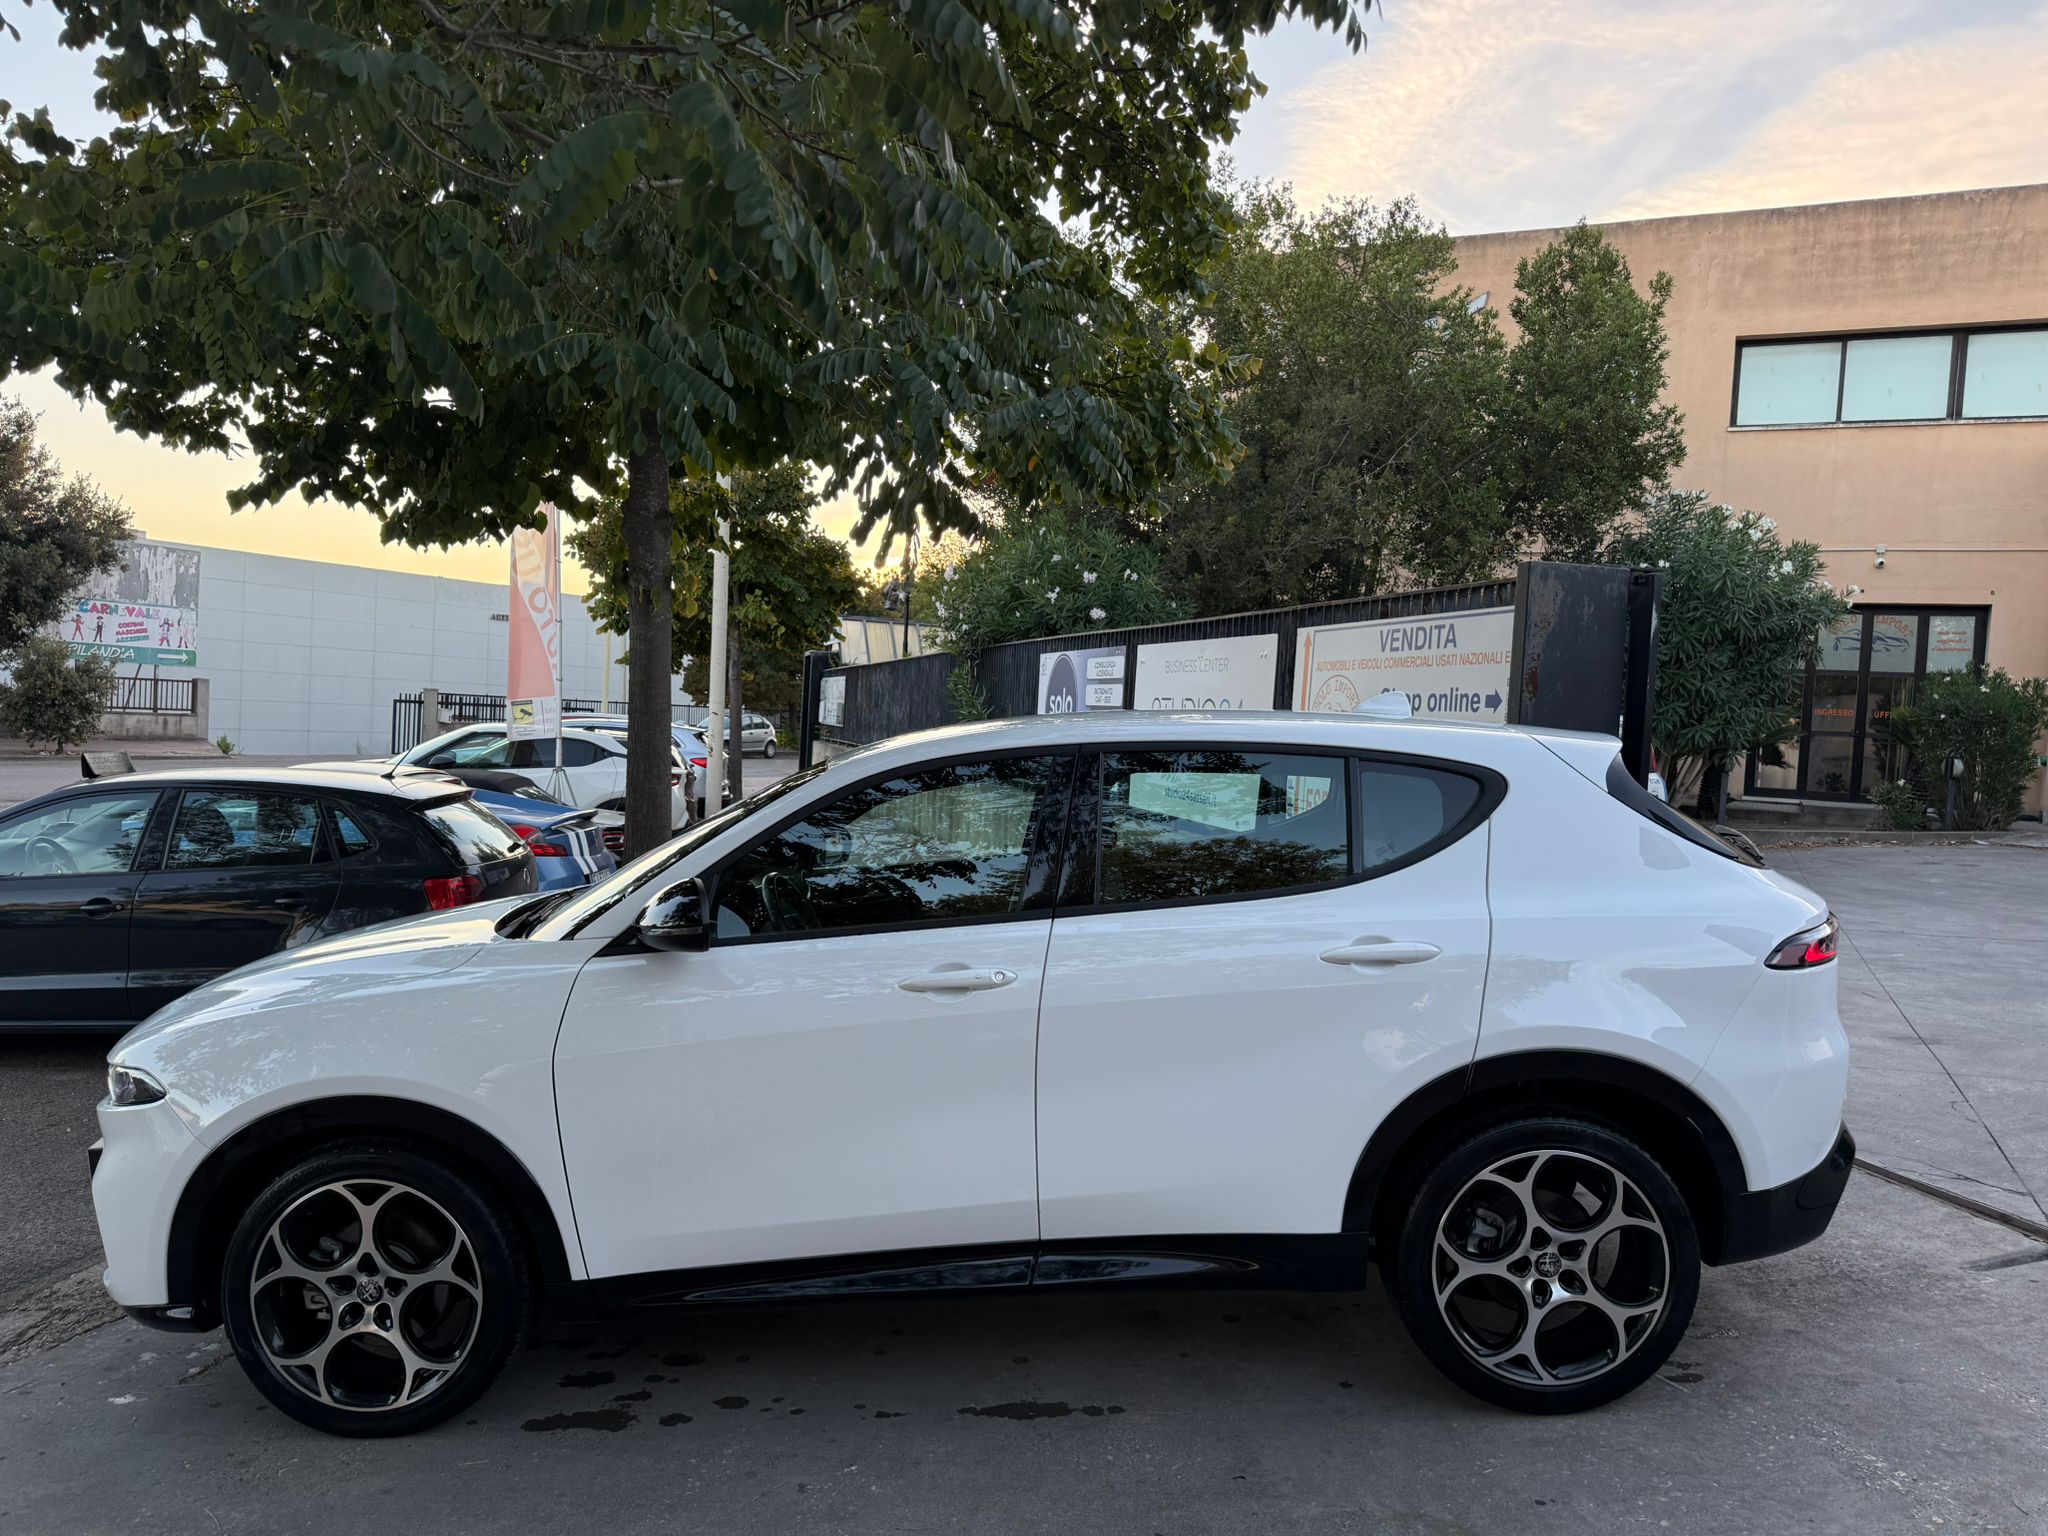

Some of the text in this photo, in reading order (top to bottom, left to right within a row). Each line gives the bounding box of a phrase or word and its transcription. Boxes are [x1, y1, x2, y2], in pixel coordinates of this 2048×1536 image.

[79, 600, 160, 620] CARNEVALE
[1380, 623, 1457, 653] VENDITA
[1165, 657, 1230, 674] BUSINESS CENTER
[1316, 661, 1350, 673] AUTOMOBILI
[1358, 658, 1382, 671] VEICOLI
[1384, 654, 1434, 669] COMMERCIALI
[1436, 653, 1457, 667] USATI
[1460, 651, 1503, 666] NAZIONALI
[1505, 650, 1511, 664] E
[1049, 687, 1073, 713] solo
[1427, 687, 1481, 713] online
[1814, 708, 1855, 717] INGRESSO
